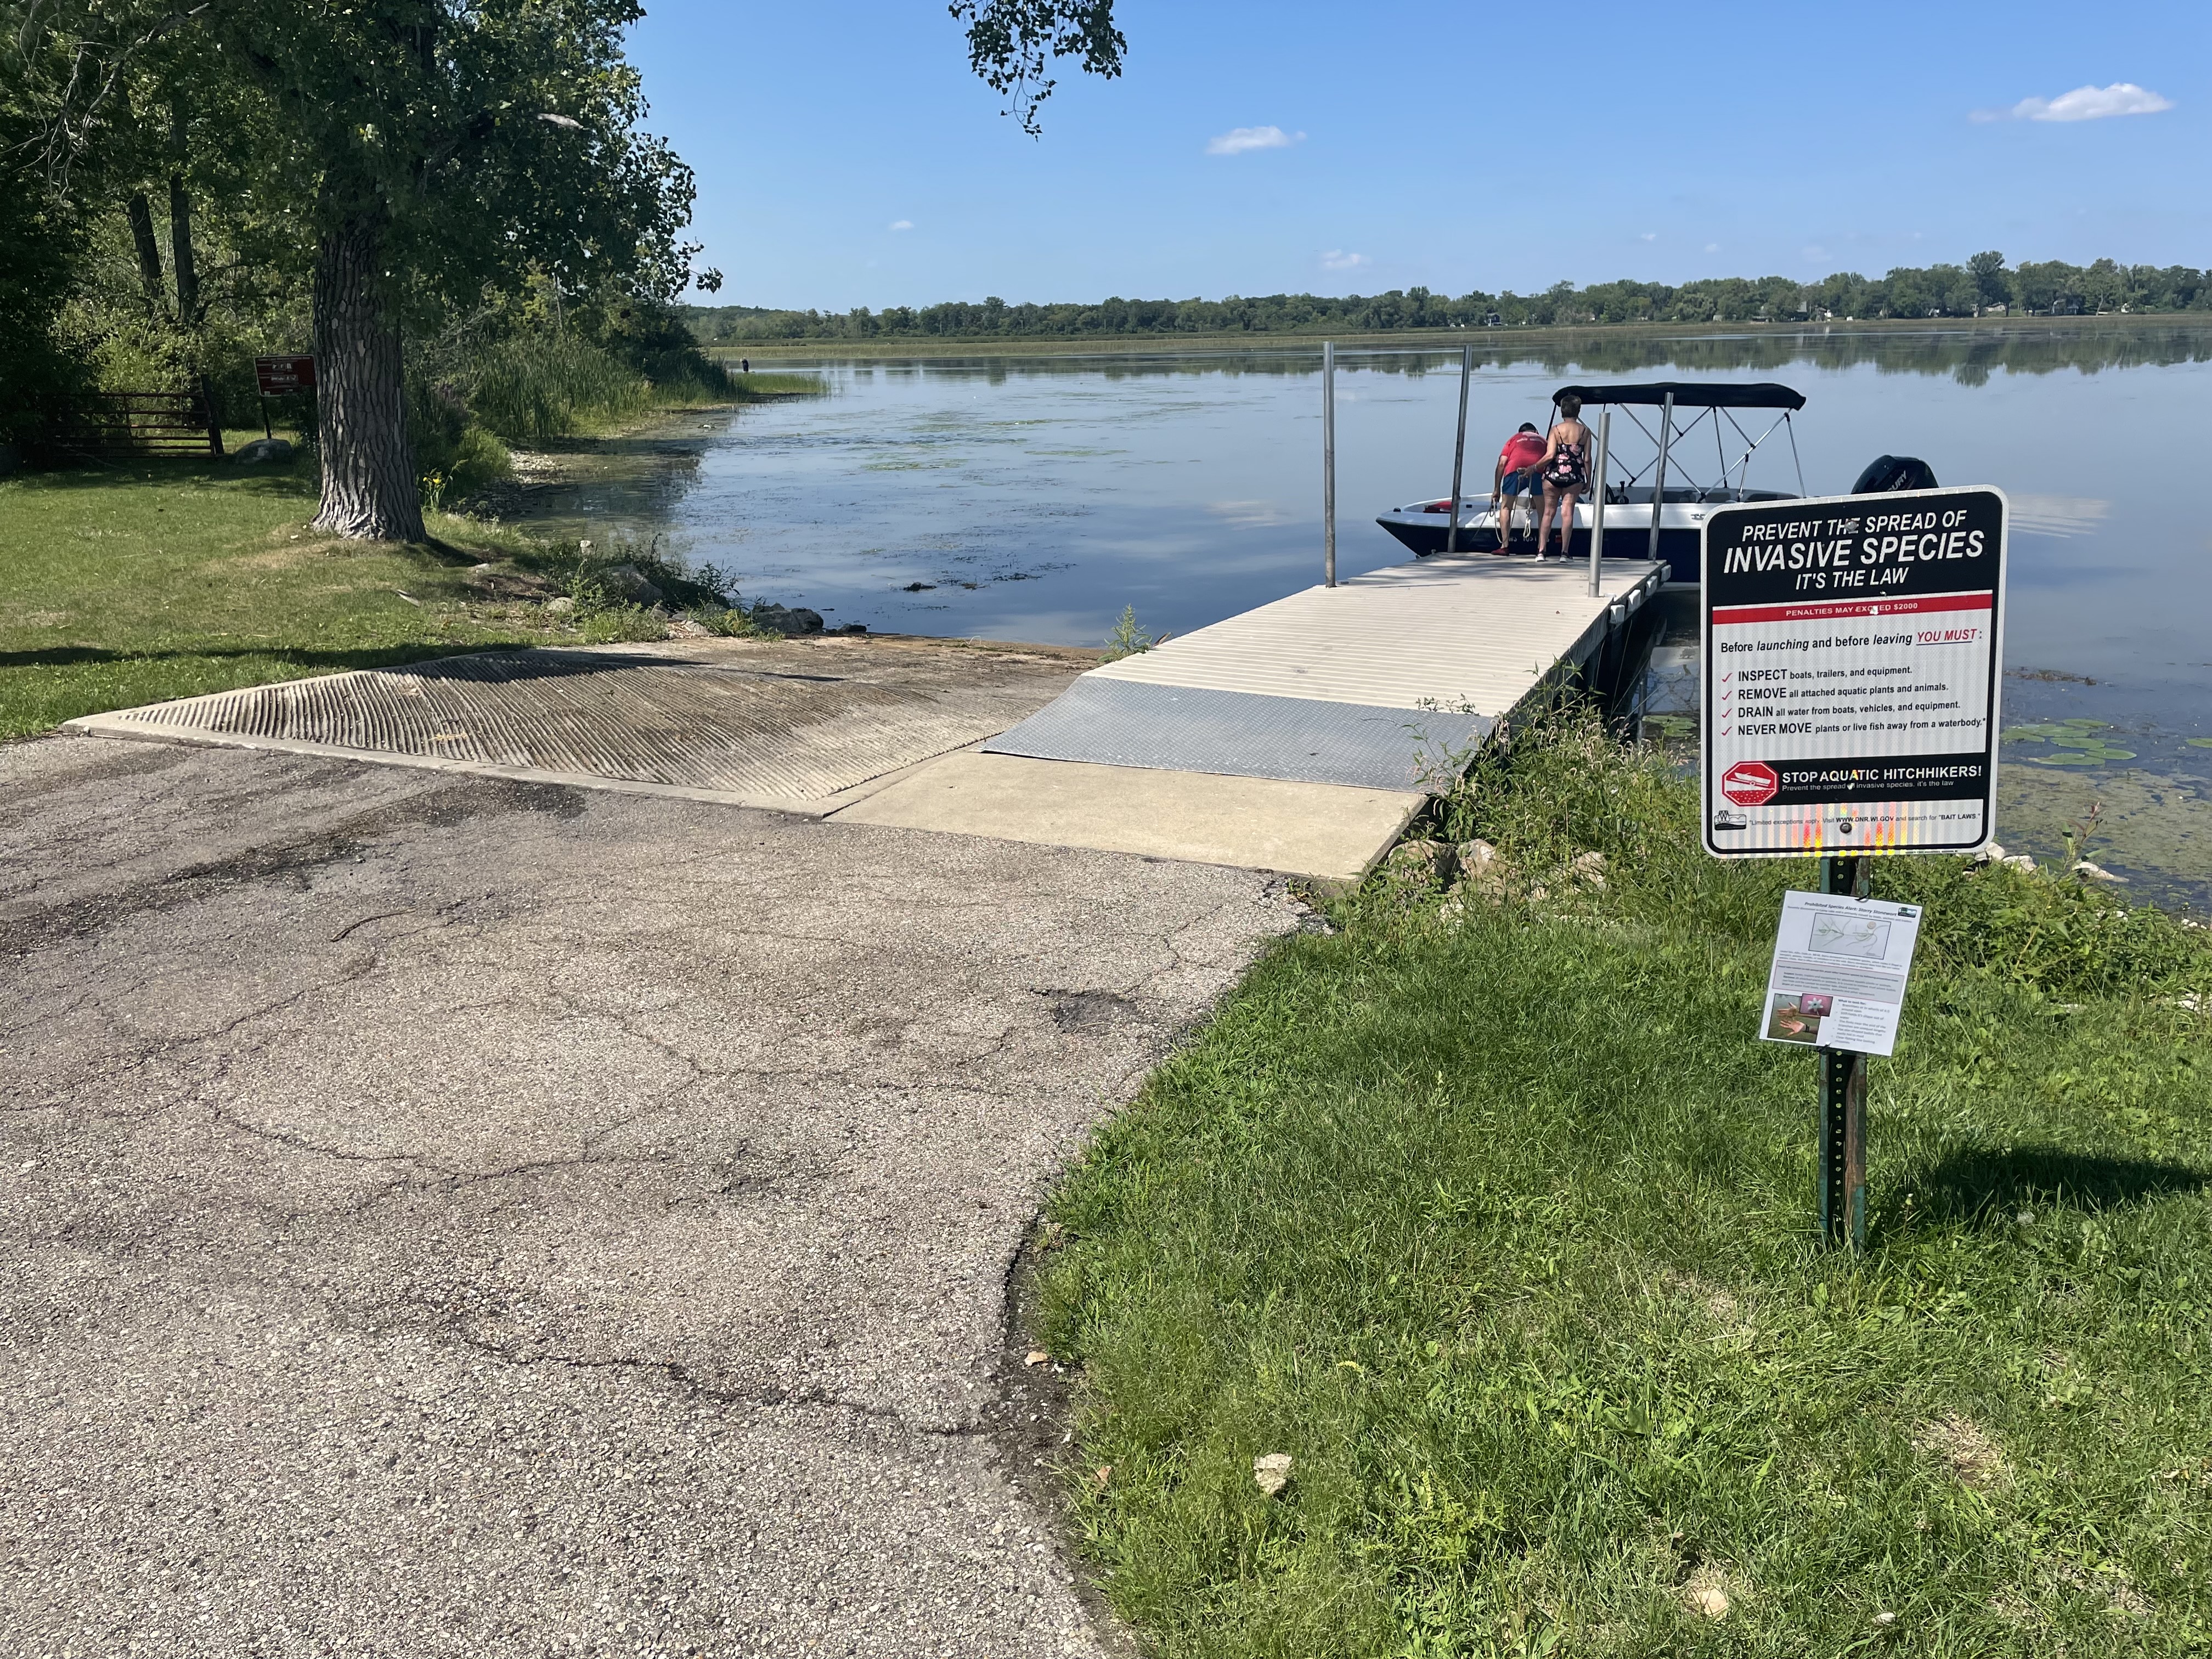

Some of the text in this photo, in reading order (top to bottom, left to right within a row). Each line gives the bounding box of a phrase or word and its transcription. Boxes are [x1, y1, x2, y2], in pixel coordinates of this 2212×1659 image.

[1742, 510, 1967, 541] PREVENT THE SPREAD OF
[1724, 530, 1985, 574] INVASIVE SPECIES
[1795, 567, 1909, 590] IT'S THE LAW
[1786, 608, 1833, 616] PENALTIES
[1720, 642, 1753, 653] Before
[1757, 638, 1809, 652] launching
[1812, 637, 1832, 648] and
[1835, 635, 1869, 647] before
[1873, 633, 1912, 647] leaving
[1917, 631, 1941, 642] YOU
[1738, 666, 1912, 681] INSPECT boats, trailers, and equipment.
[1738, 683, 1949, 699] REMOVE all attached aquatic plants and animals.
[1738, 701, 1960, 718] DRAIN all water from boats, vehicles, and equipment.
[1738, 724, 1776, 735] NEVER
[1779, 723, 1812, 734] MOVE
[1815, 724, 1840, 734] plants
[1887, 722, 1908, 731] away
[1782, 765, 1982, 783] STOP AQUATIC HITCHHIKERS!
[1823, 782, 1846, 791] spread
